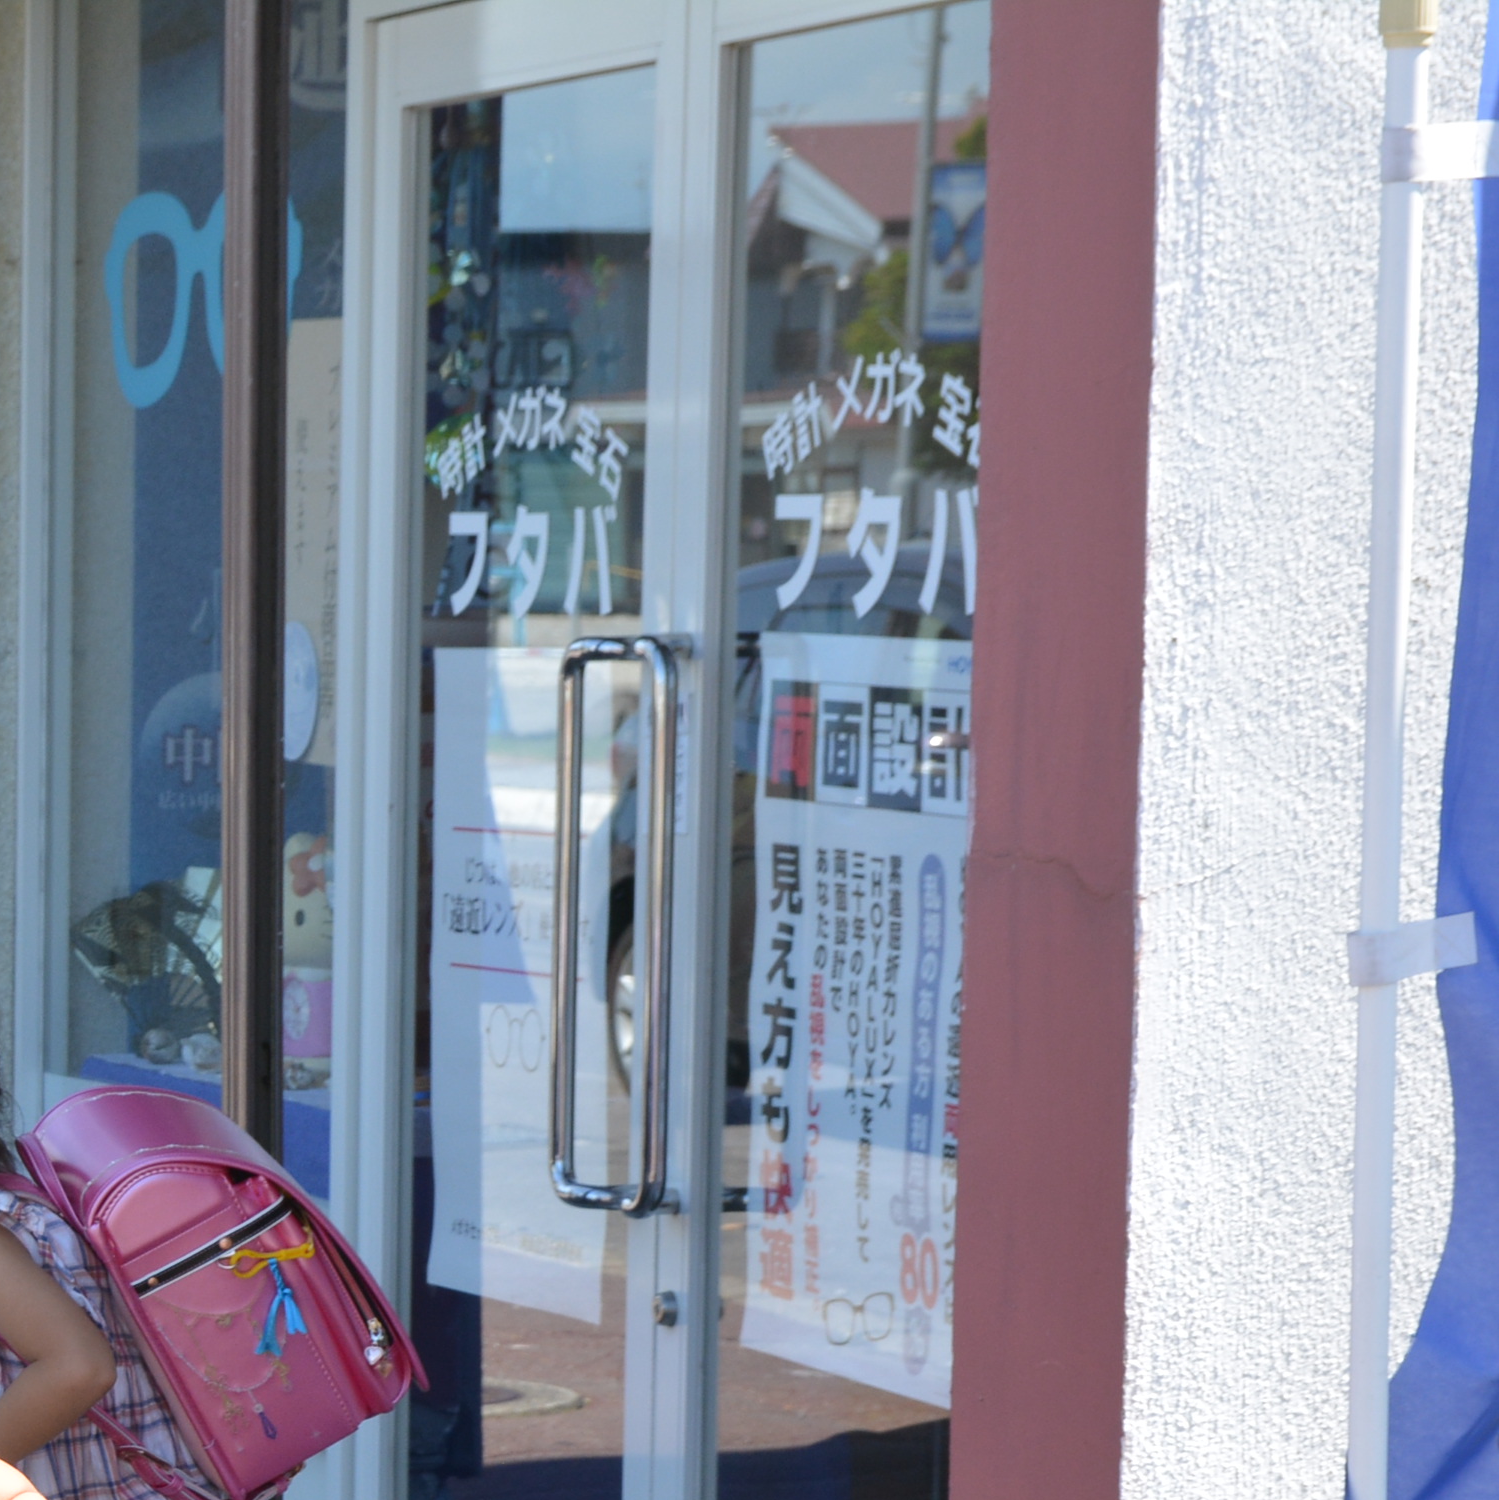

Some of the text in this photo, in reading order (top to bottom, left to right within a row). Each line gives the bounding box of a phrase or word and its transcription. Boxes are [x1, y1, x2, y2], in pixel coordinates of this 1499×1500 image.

[435, 386, 629, 502] 時計 メガネ 宝石
[760, 382, 824, 480] 時計
[834, 348, 926, 430] メガネ
[447, 505, 618, 617] フタバ
[759, 843, 801, 1301] 見え方も快適
[900, 1233, 939, 1309] 80
